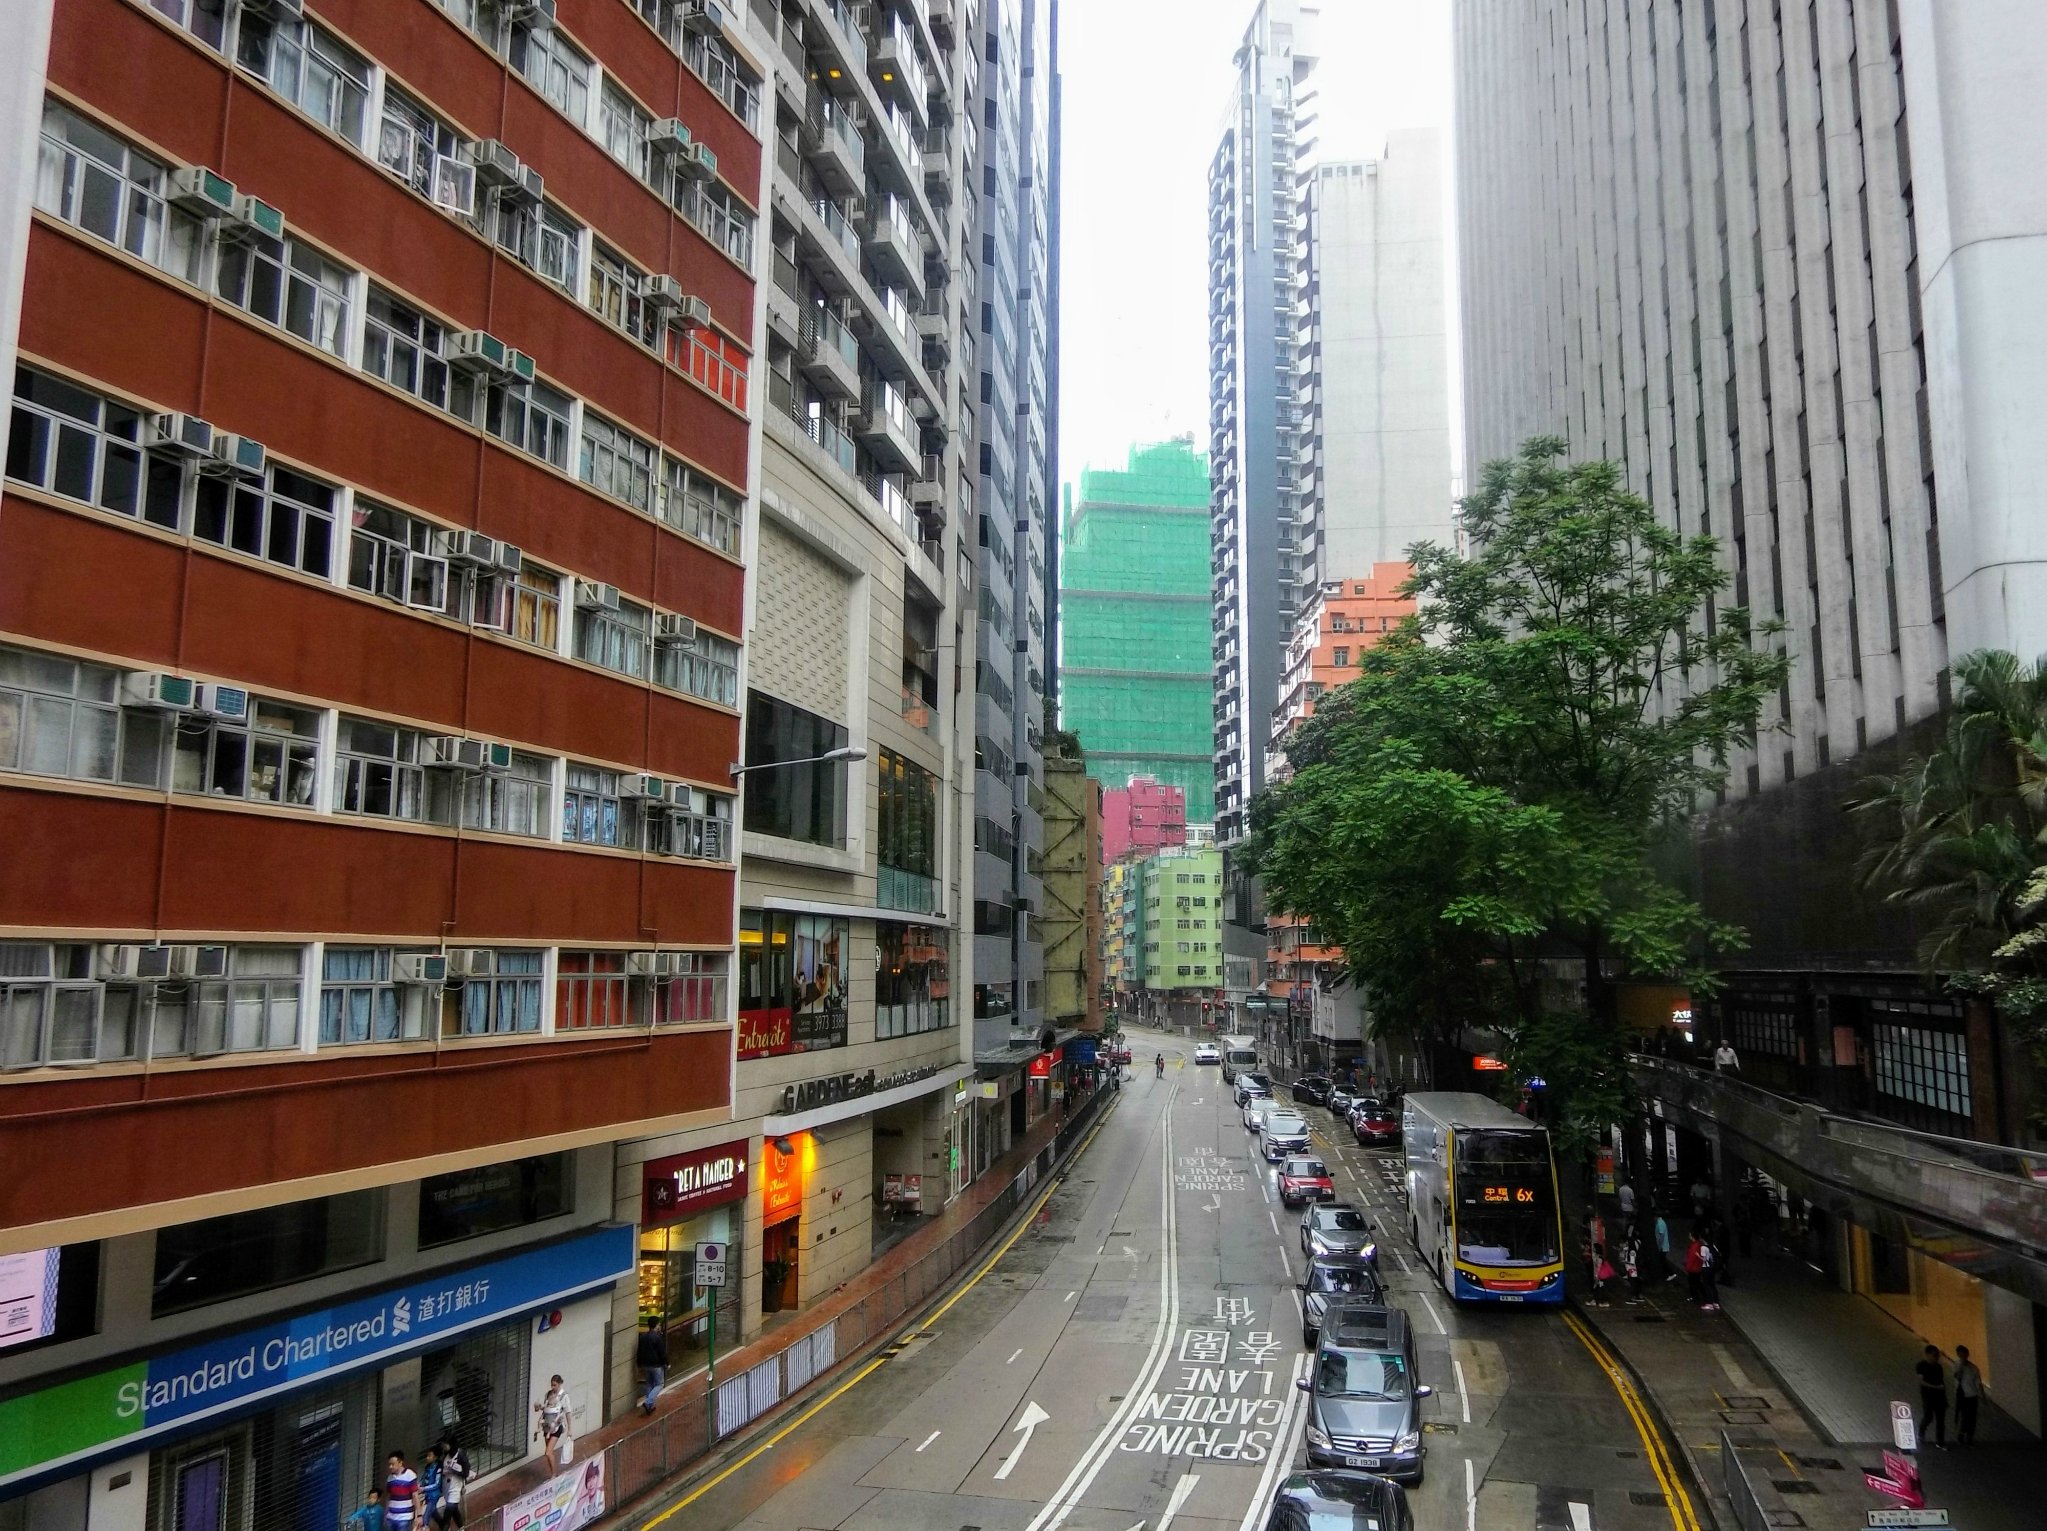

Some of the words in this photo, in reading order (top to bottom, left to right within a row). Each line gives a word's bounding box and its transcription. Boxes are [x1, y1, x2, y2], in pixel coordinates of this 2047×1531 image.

[815, 1015, 829, 1033] 3973
[695, 1167, 700, 1190] A
[703, 1157, 734, 1187] MANGER
[1174, 1174, 1244, 1182] GARDEN
[1176, 1181, 1246, 1191] SPRING
[1184, 1167, 1232, 1176] LANE
[418, 1280, 490, 1322] 渣打銀行
[1213, 1297, 1257, 1326] 街
[116, 1347, 256, 1417] Standard
[263, 1314, 386, 1372] Chartered
[1175, 1368, 1274, 1395] LANE
[1139, 1393, 1285, 1426] GARDEN
[1120, 1425, 1273, 1461] SPRING
